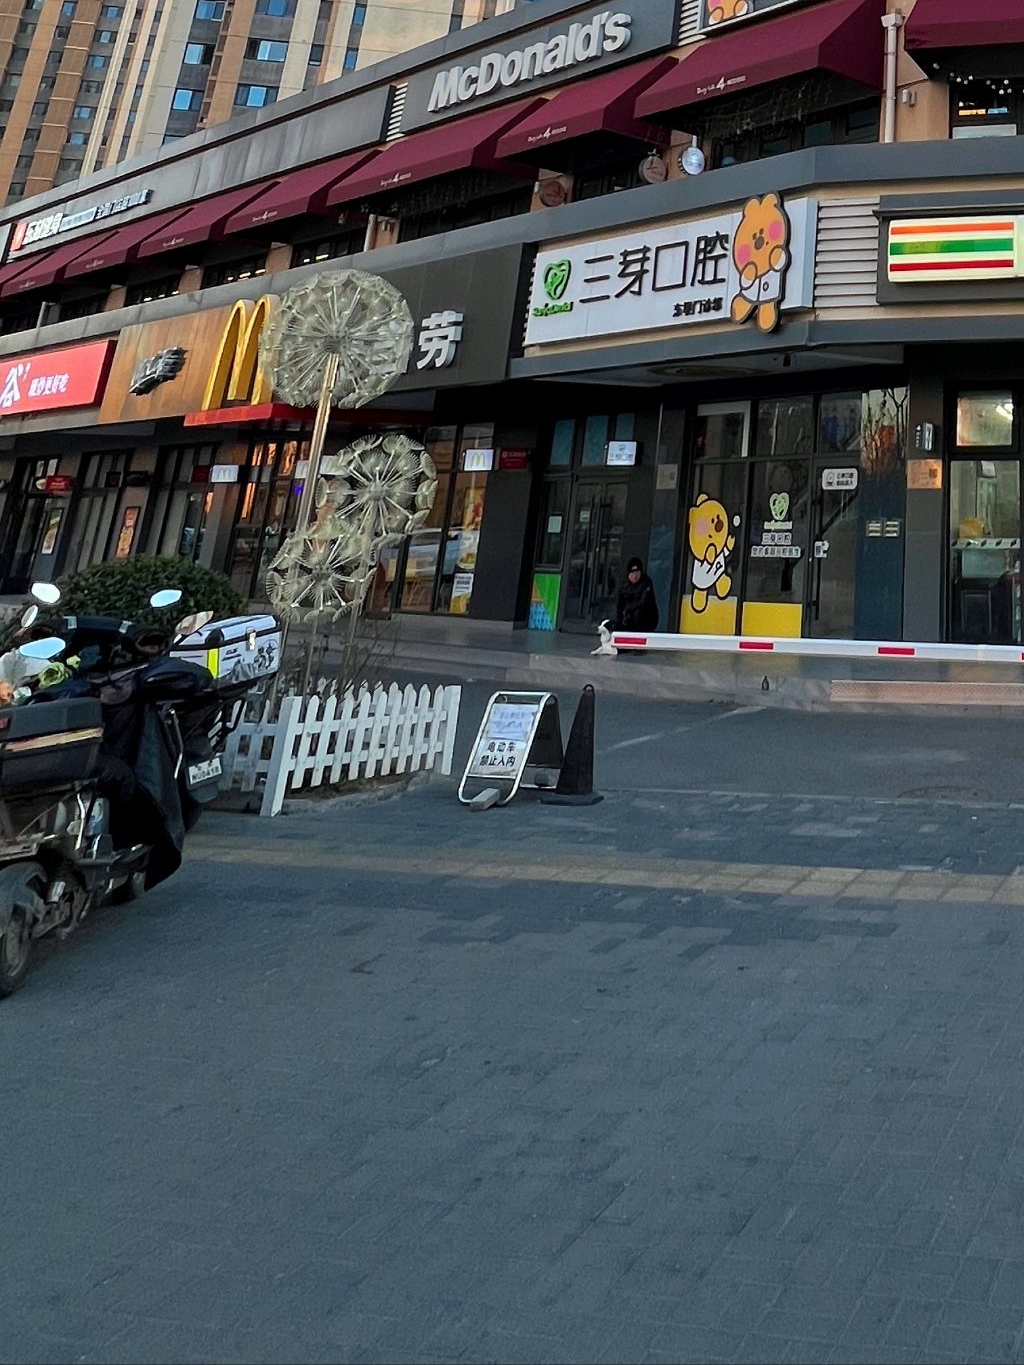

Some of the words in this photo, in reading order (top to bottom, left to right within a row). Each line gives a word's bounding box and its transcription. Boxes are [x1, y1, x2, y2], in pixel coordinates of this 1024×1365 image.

[427, 11, 633, 113] McDonald's
[579, 231, 729, 303] 三芽口腔
[480, 755, 516, 767] 禁止入内
[487, 741, 516, 753] 电动车
